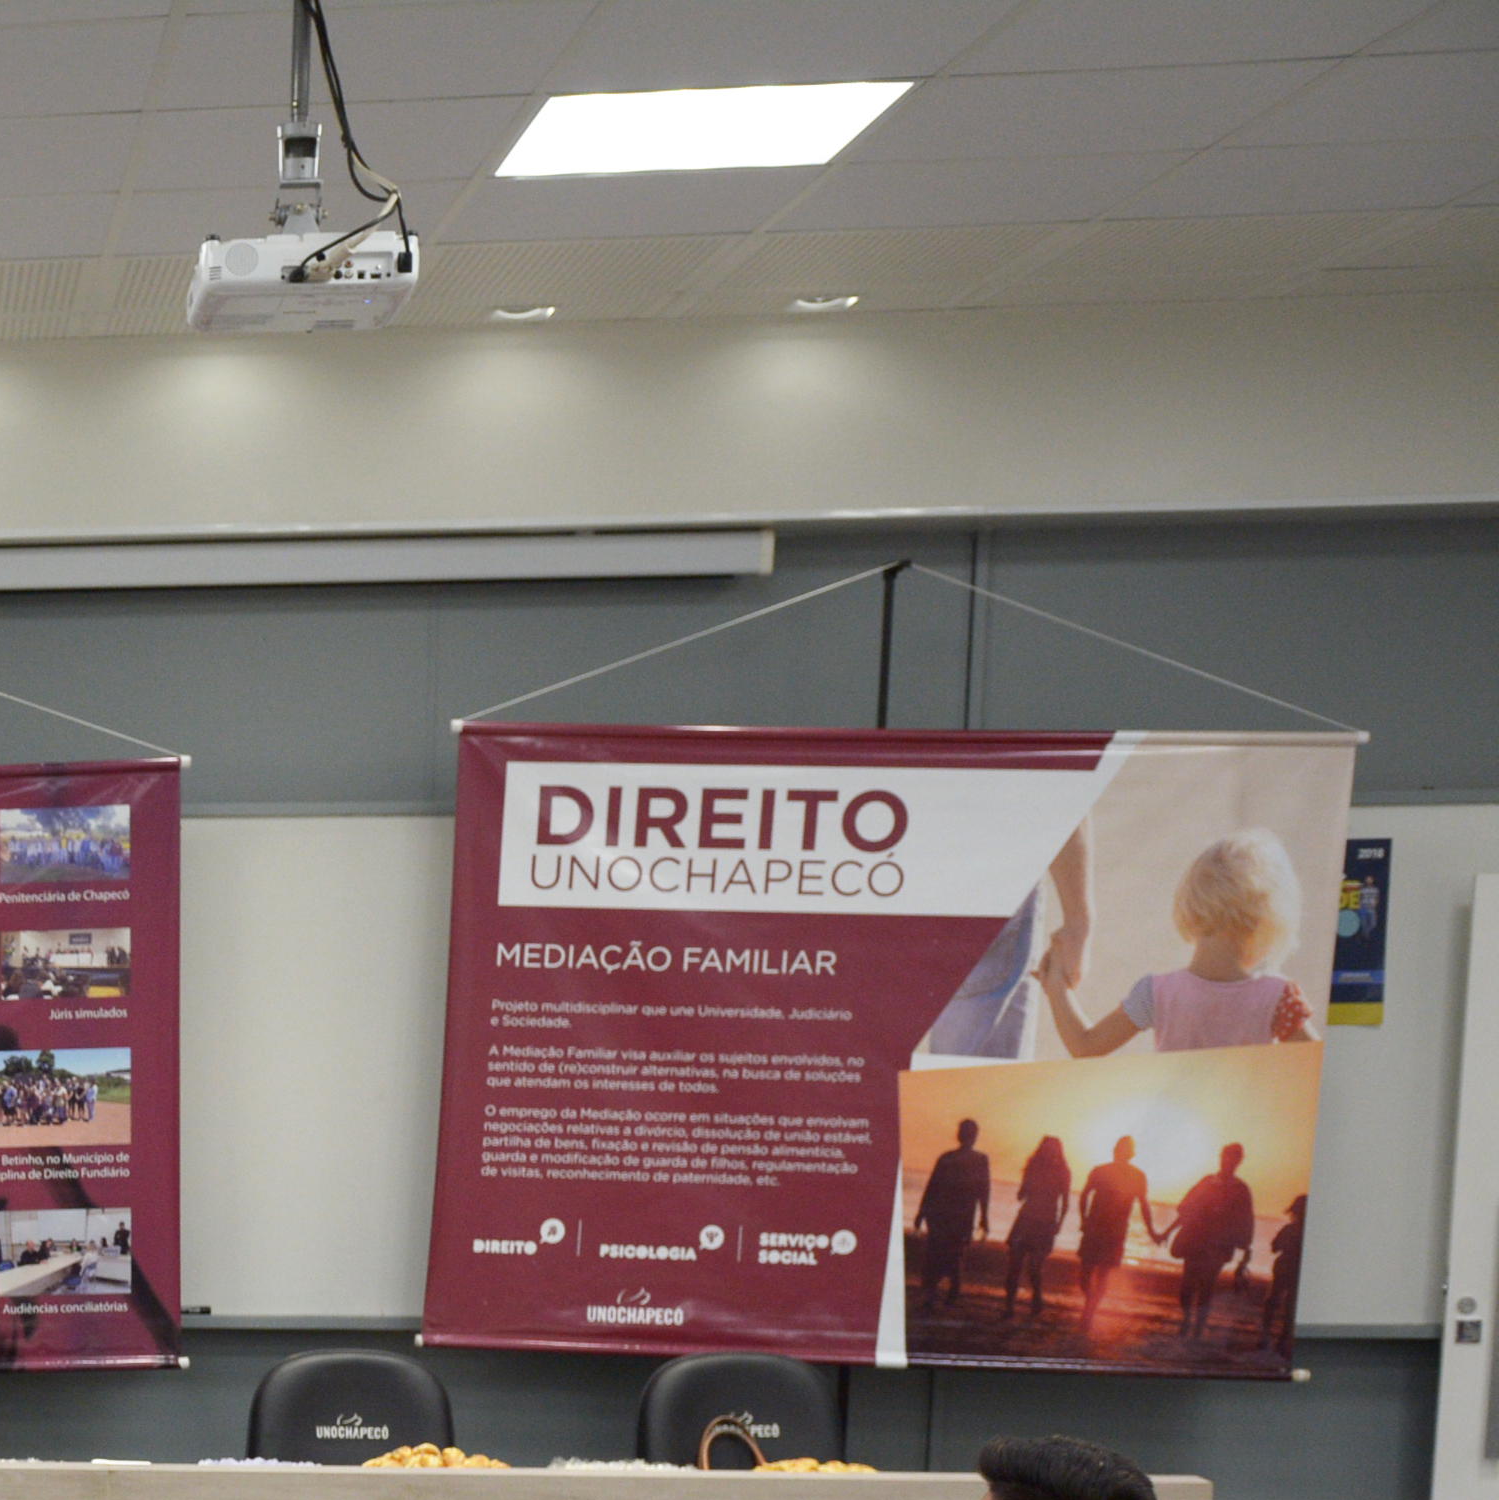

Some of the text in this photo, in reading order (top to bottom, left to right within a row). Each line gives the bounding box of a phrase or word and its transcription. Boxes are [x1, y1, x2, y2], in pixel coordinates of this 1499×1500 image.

[536, 784, 909, 854] DIREITO
[530, 853, 905, 898] UNOCHAPECÓ
[82, 887, 130, 903] Chapecó
[495, 940, 837, 976] MEDIAÇÃO FAMILIAR
[48, 1006, 128, 1020] Júris simulados
[491, 998, 853, 1021] Projeto multidisciplinar que une Universidade, Judiciário
[503, 1014, 573, 1028] Sociedade.
[502, 1044, 565, 1060] Mediação
[566, 1046, 618, 1059] Familiar
[621, 1048, 647, 1060] visa
[649, 1048, 696, 1062] auxiliar
[718, 1051, 769, 1067] sujeitos
[770, 1052, 843, 1069] envolvidos,
[488, 1058, 536, 1072] sentido
[641, 1063, 717, 1080] alternativas,
[742, 1066, 781, 1080] busca
[805, 1068, 861, 1085] soluções
[486, 1075, 720, 1093] que atendam interesses todos.
[499, 1106, 557, 1121] emprego
[580, 1107, 642, 1123] Mediação
[644, 1111, 686, 1122] ocorre
[714, 1111, 775, 1128] situações
[778, 1115, 803, 1129] que
[806, 1114, 869, 1128] envolvam
[483, 1119, 564, 1136] negociações
[566, 1122, 620, 1135] relativas
[634, 1124, 687, 1140] divórcio,
[692, 1126, 761, 1142] dissolução
[823, 1130, 873, 1146] estável,
[482, 1134, 532, 1150] partilha
[553, 1136, 588, 1152] bens,
[591, 1137, 638, 1153] fixação
[651, 1139, 698, 1153] revisão
[720, 1142, 769, 1158] pensão
[43, 1166, 80, 1179] Direito
[80, 1165, 131, 1178] Fundiário
[481, 1149, 528, 1165] guarda
[540, 1151, 621, 1168] modificação
[642, 1154, 688, 1170] guarda
[710, 1156, 749, 1172] filhos,
[751, 1158, 859, 1176] regulamentação
[500, 1164, 544, 1180] visitas,
[546, 1166, 651, 1181] reconhecimento
[755, 1173, 779, 1186] etc.
[473, 1239, 538, 1256] DIREITO
[759, 1232, 830, 1250] SERVIÇO
[599, 1244, 697, 1262] PSICOLOGIA
[758, 1250, 818, 1266] SOCIAL
[3, 1300, 128, 1314] Audiências conciliatórias
